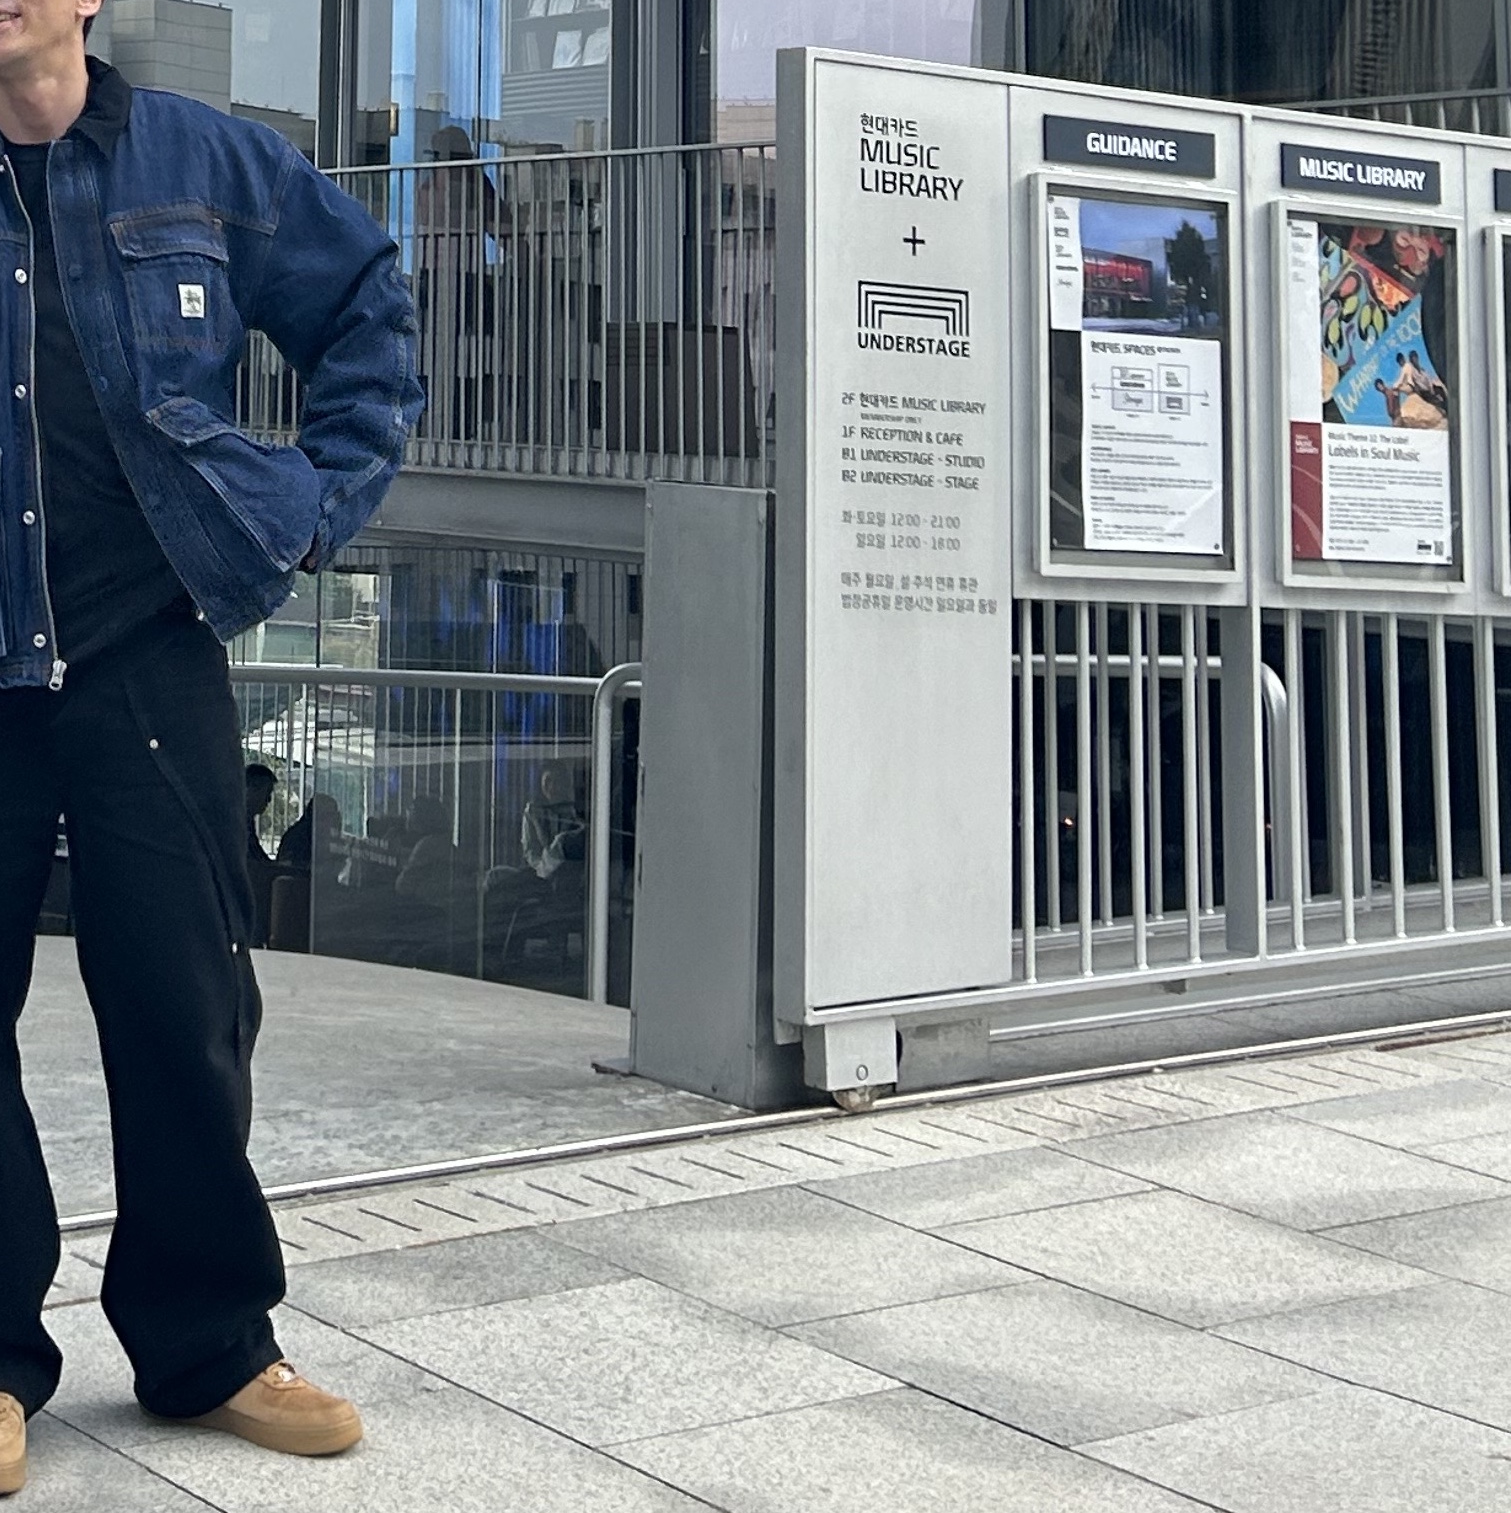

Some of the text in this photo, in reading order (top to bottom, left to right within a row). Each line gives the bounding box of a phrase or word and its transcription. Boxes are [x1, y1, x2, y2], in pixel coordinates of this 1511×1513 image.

[860, 113, 919, 138] 현대카드
[860, 138, 941, 170] MUSIC
[1086, 132, 1178, 162] GUIDANCE
[860, 167, 965, 201] LIBRARY
[1299, 156, 1426, 191] MUSIC LIBRARY
[857, 332, 971, 358] UNDERSTAGE
[940, 399, 986, 414] LIBRARY
[861, 427, 923, 443] RECEPTION
[861, 449, 934, 465] UNDERSTAGE
[861, 471, 934, 487] UNDERSTAGE
